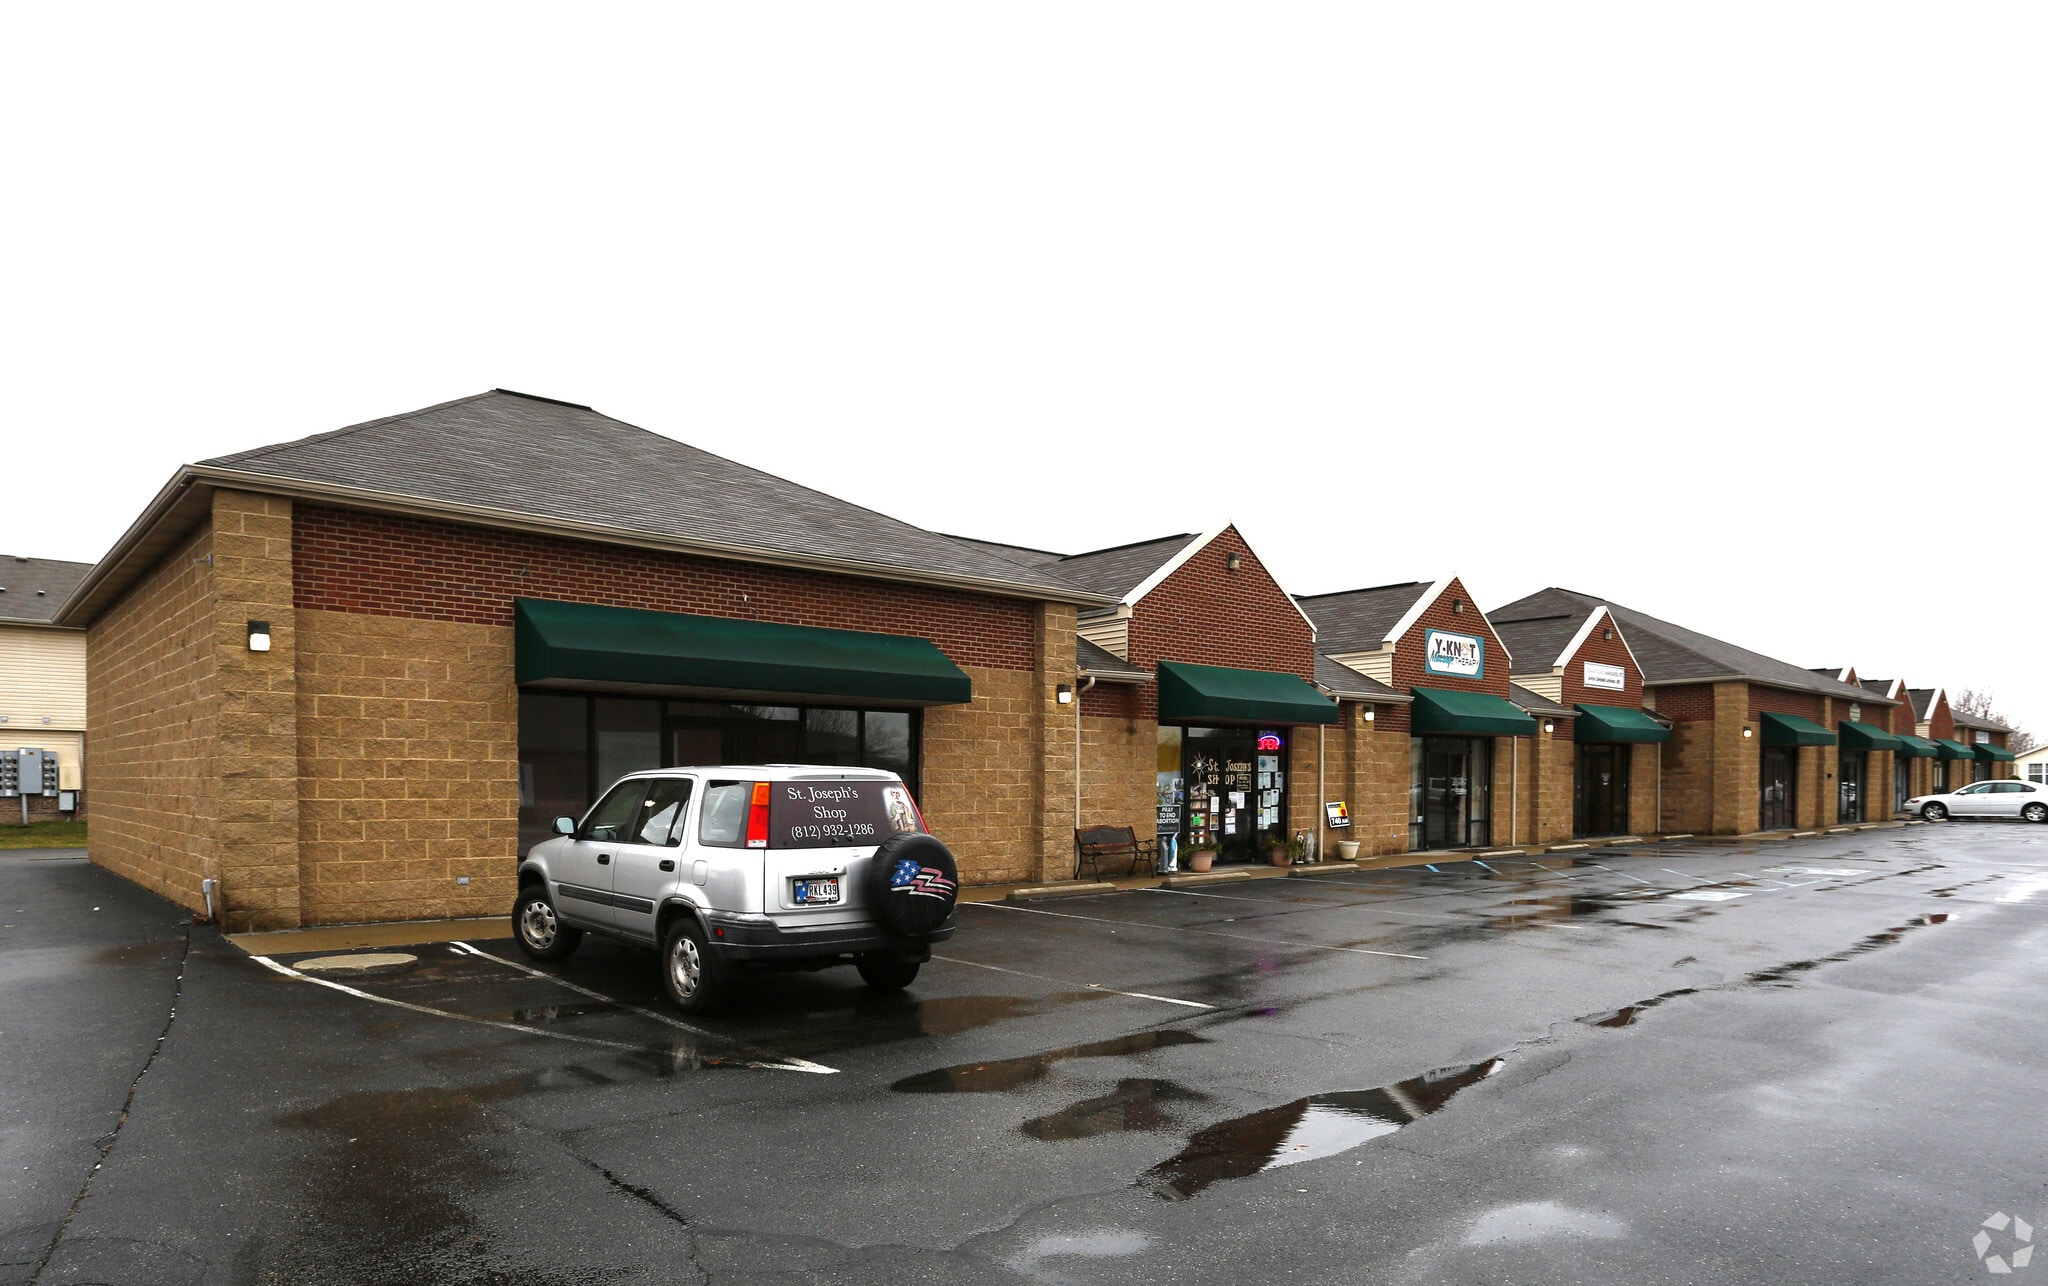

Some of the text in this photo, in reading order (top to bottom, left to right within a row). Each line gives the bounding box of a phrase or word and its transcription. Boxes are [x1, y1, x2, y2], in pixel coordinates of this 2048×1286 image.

[1257, 738, 1280, 750] OPEN
[787, 786, 859, 803] St. Joseph's
[813, 805, 847, 822] Shop
[791, 823, 875, 842] (812) 932-1286
[809, 884, 837, 896] RKL439
